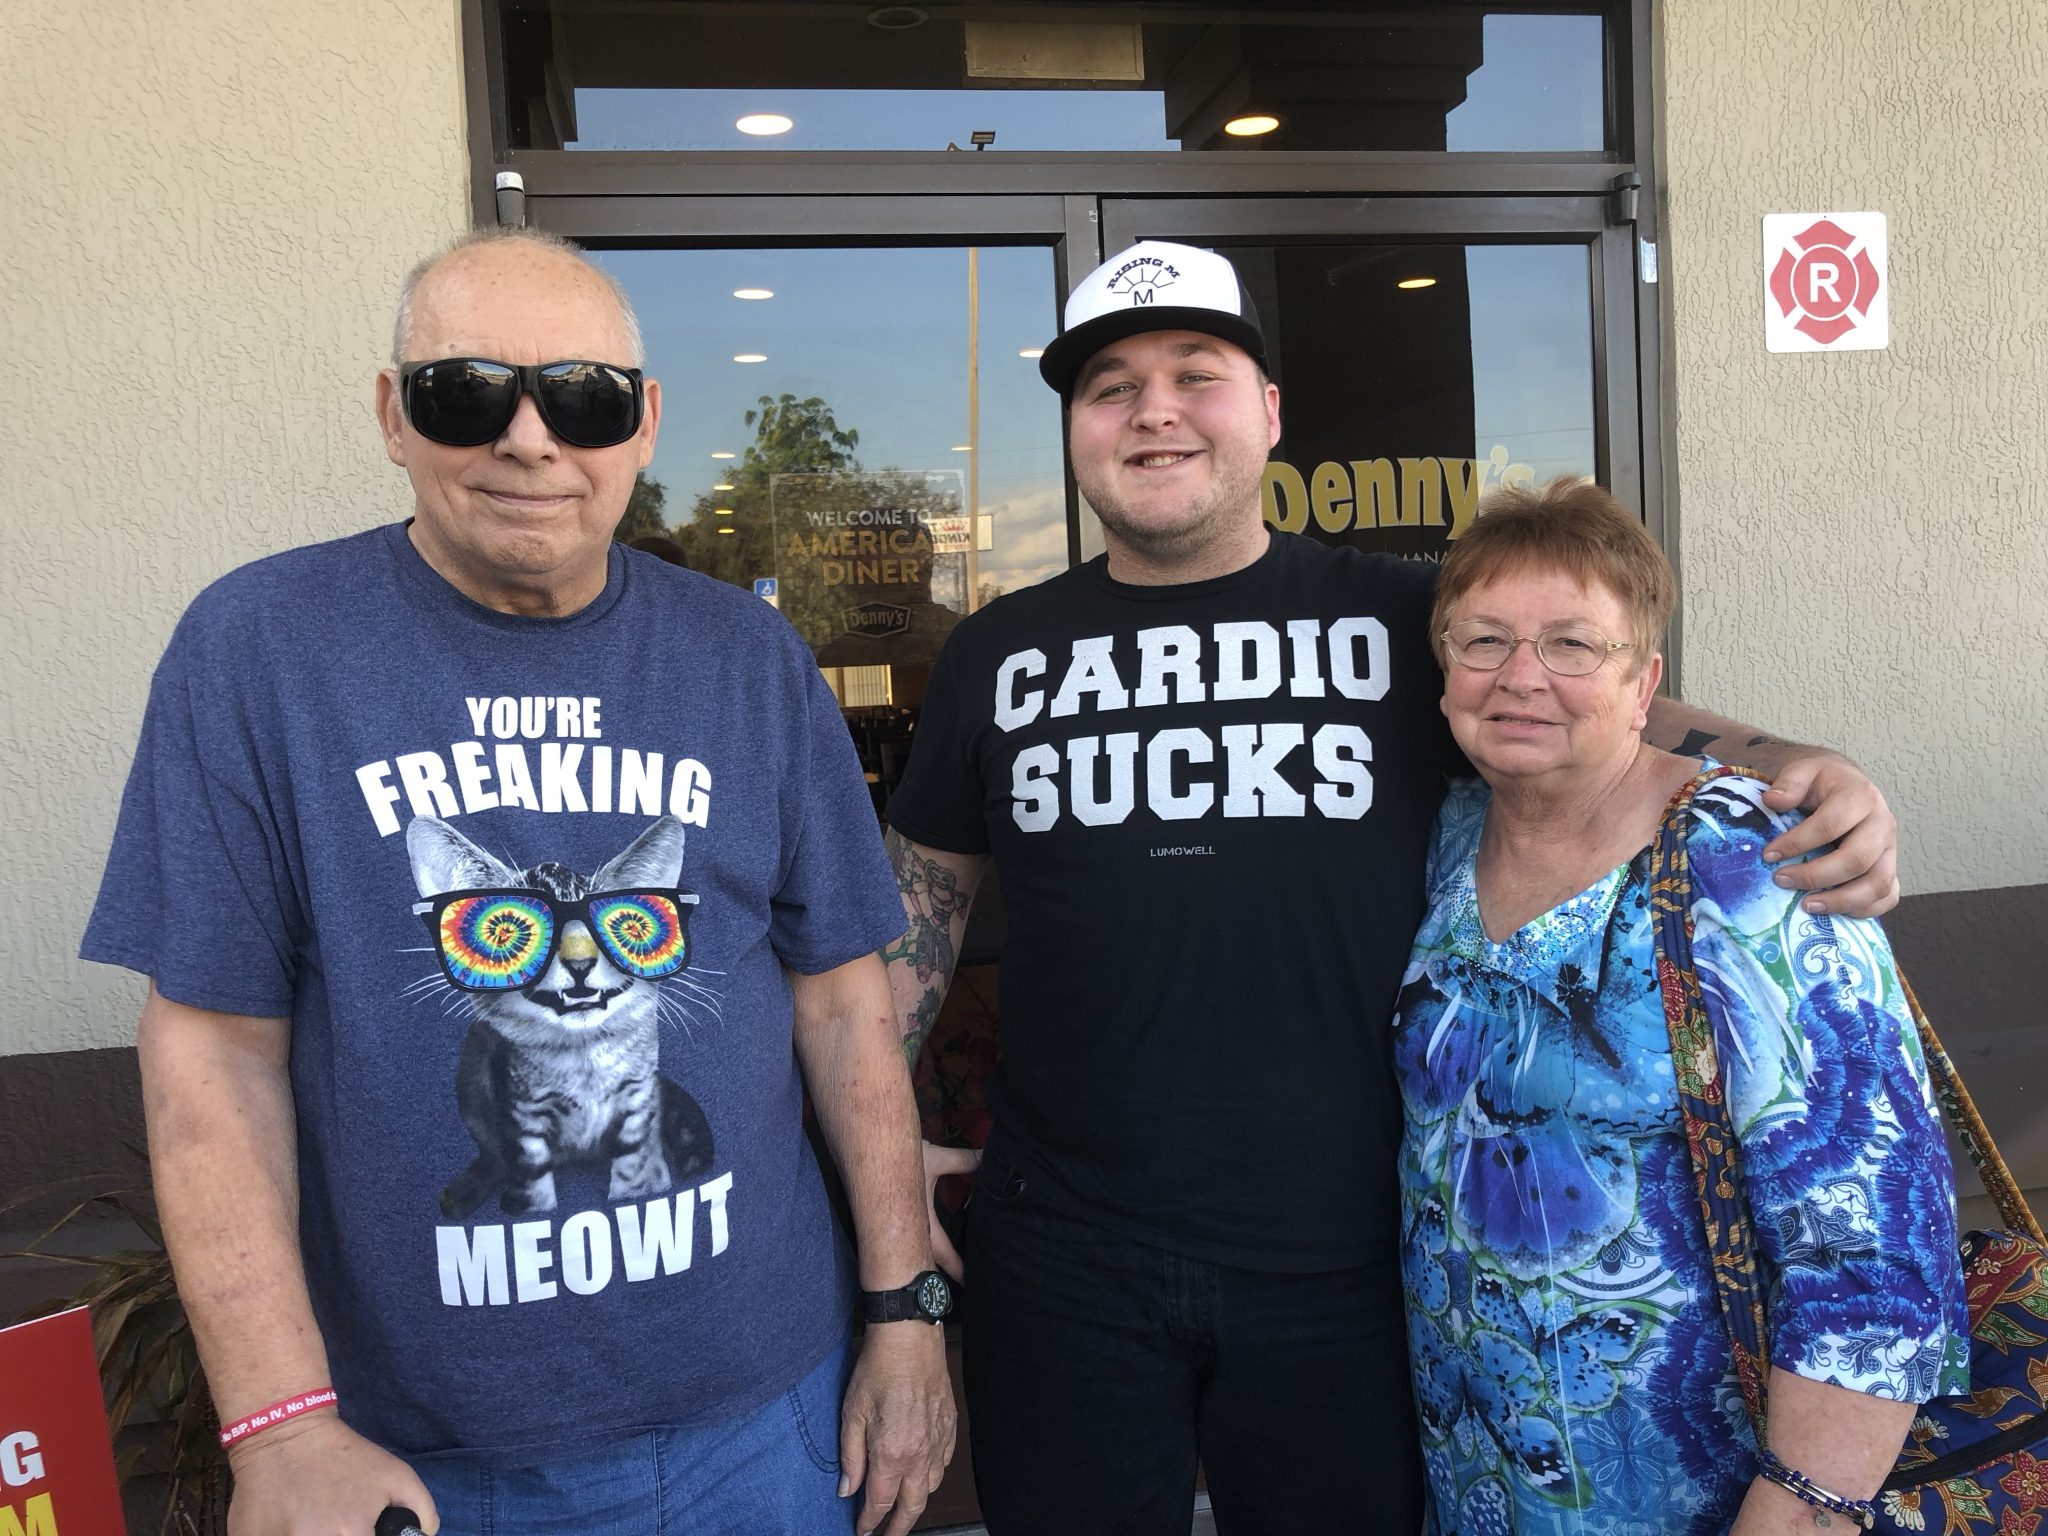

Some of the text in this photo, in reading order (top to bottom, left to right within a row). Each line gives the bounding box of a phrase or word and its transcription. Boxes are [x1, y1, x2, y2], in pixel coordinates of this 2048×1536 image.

[1107, 257, 1180, 289] RISING M
[1809, 262, 1842, 303] R
[1134, 289, 1154, 306] M
[806, 508, 931, 528] WELCOME TO
[822, 558, 920, 586] DINER
[849, 608, 905, 628] Denny's
[993, 616, 1391, 733] CARDIO
[465, 696, 602, 739] YOU'RE
[355, 741, 712, 838] FREAKING
[1011, 723, 1374, 833] SUCKS
[1150, 845, 1216, 857] LUMOWELL
[435, 1171, 733, 1306] MEOWT
[251, 1416, 269, 1428] No
[286, 1402, 304, 1414] No
[305, 1391, 331, 1406] blood
